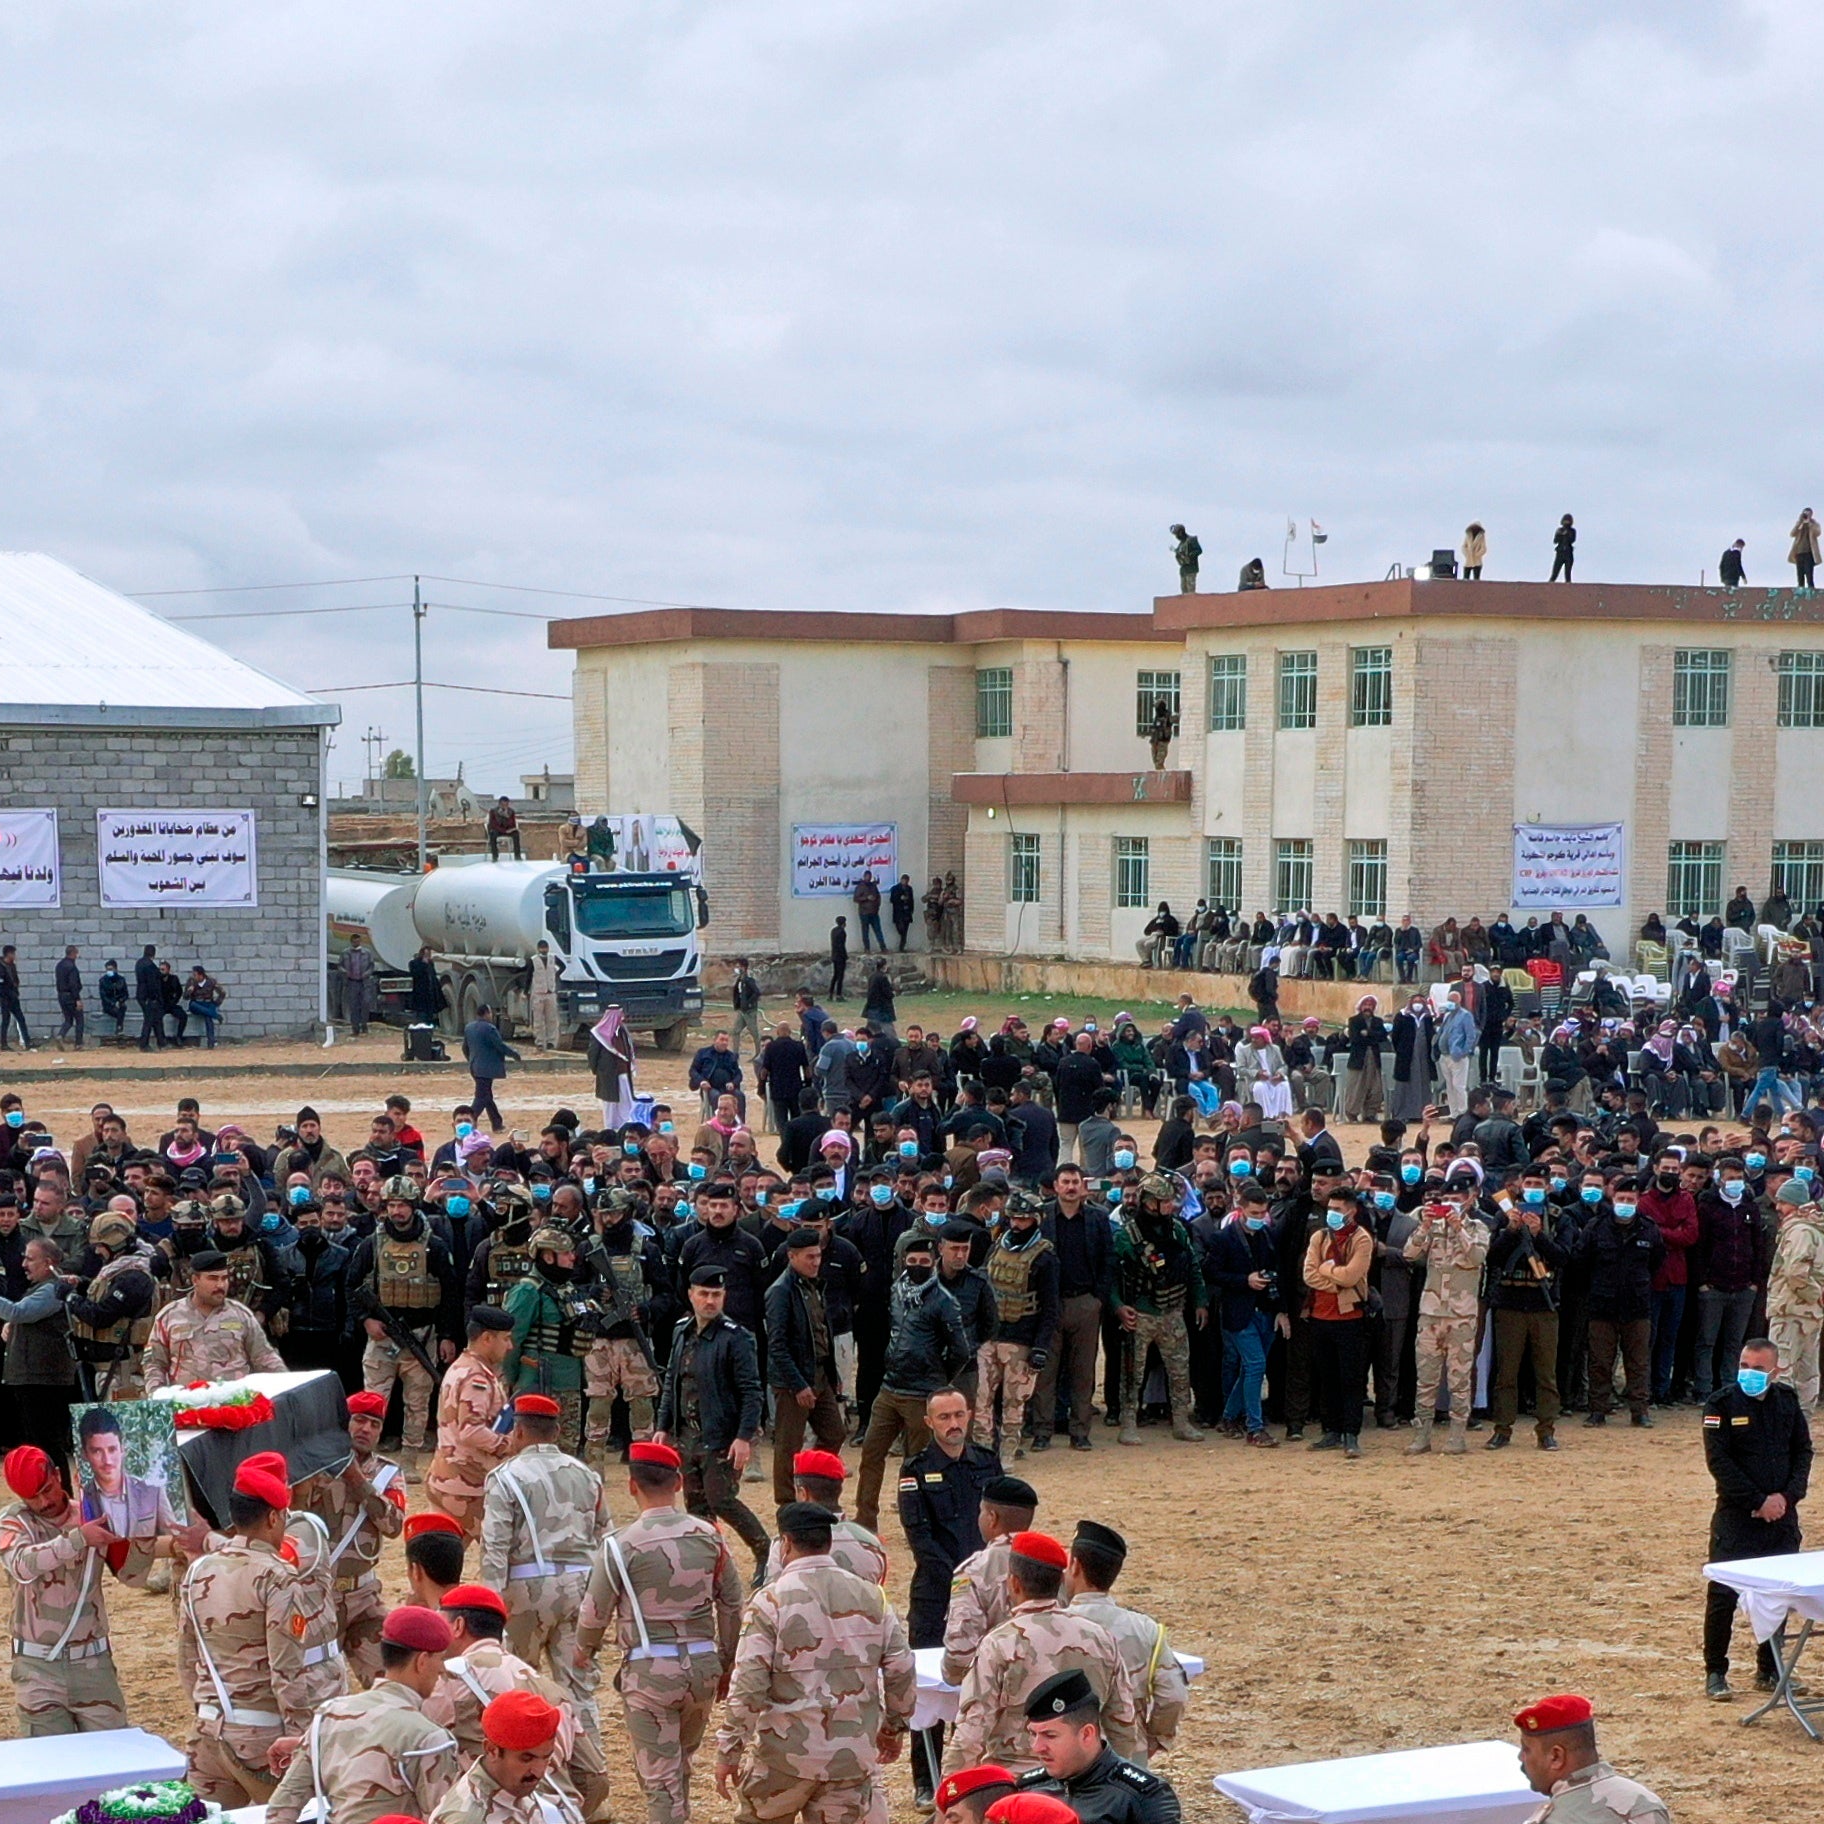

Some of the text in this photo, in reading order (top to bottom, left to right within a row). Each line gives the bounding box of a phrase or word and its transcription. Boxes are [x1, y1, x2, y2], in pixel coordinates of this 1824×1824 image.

[112, 821, 236, 838] من عظام ضحايانا المغدورين
[105, 849, 138, 866] والسلم
[167, 852, 194, 866] جسور
[196, 850, 220, 868] نبني
[221, 851, 246, 865] سوف
[24, 865, 53, 885] ولدنا
[147, 878, 206, 894] بين الشعوب
